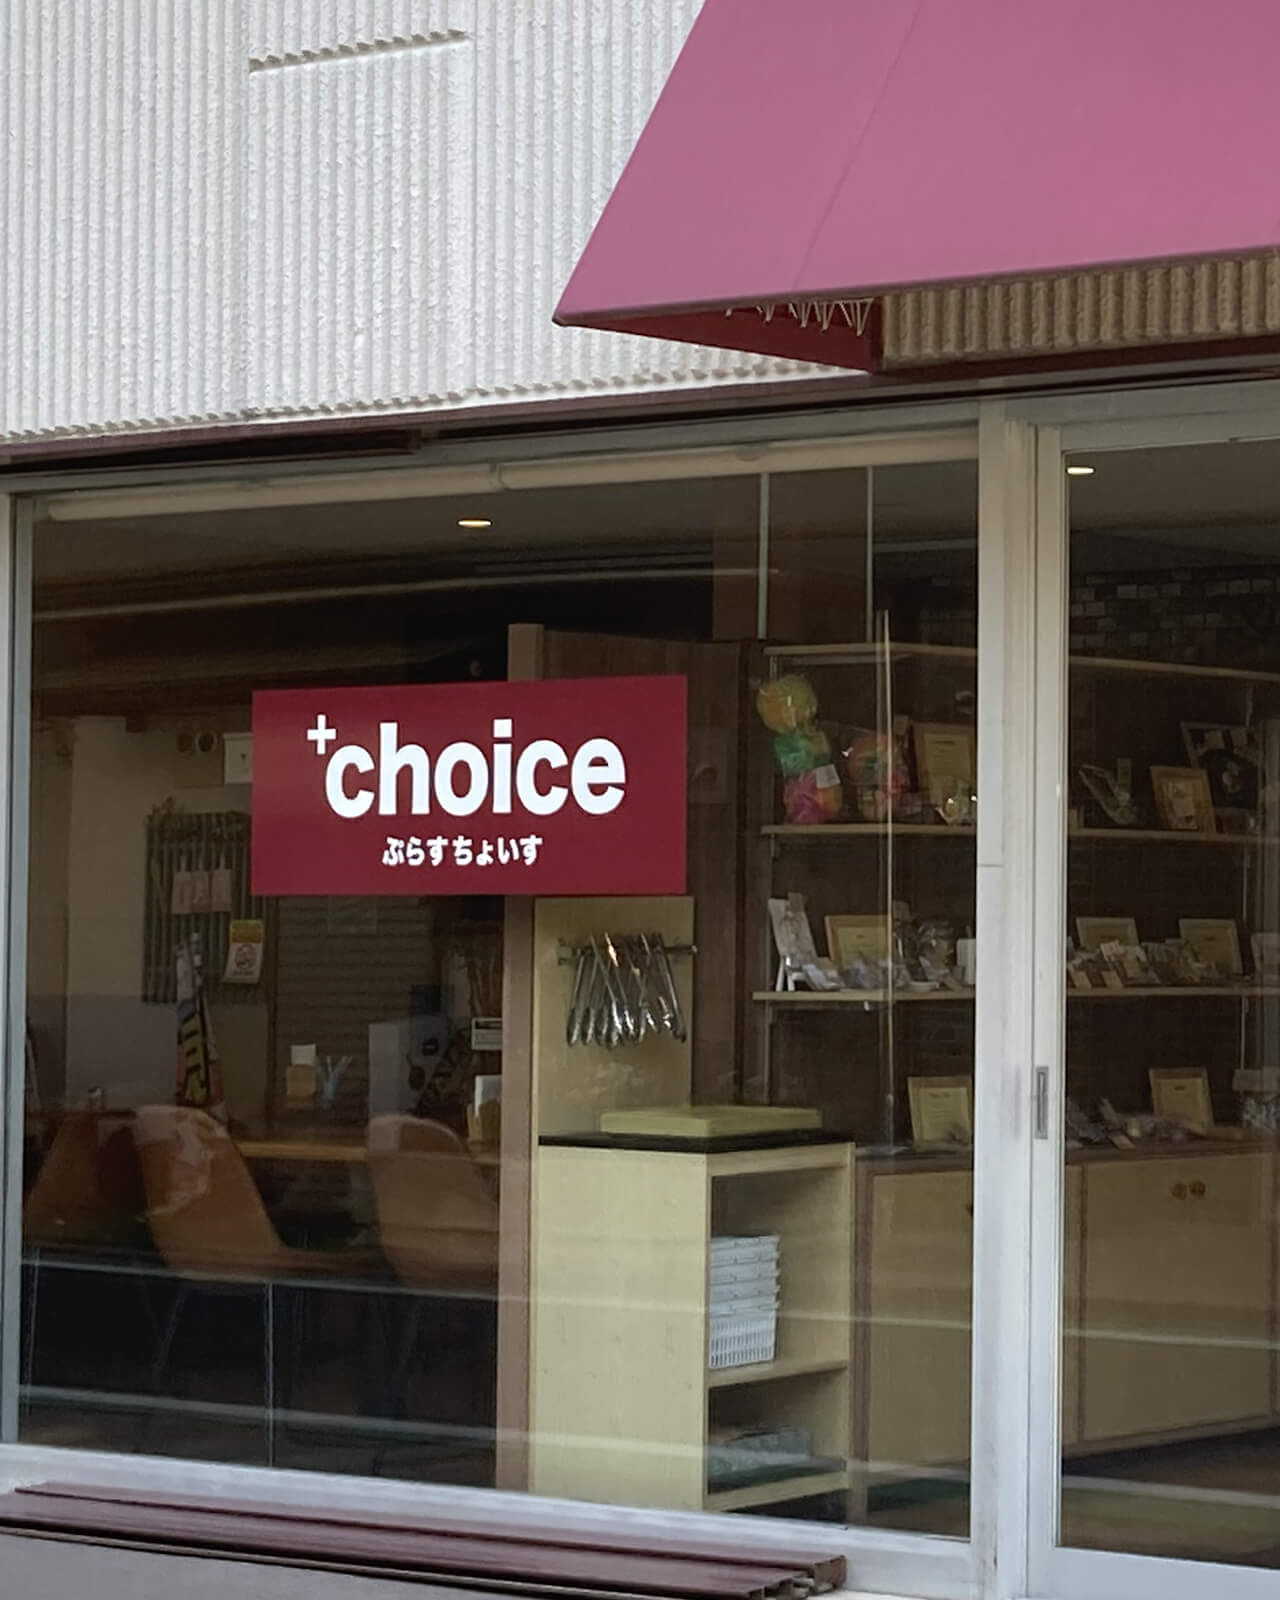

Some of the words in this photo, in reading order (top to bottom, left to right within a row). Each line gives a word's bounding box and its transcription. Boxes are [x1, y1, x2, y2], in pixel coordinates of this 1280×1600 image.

[381, 834, 543, 867] ぷらすちょいす
